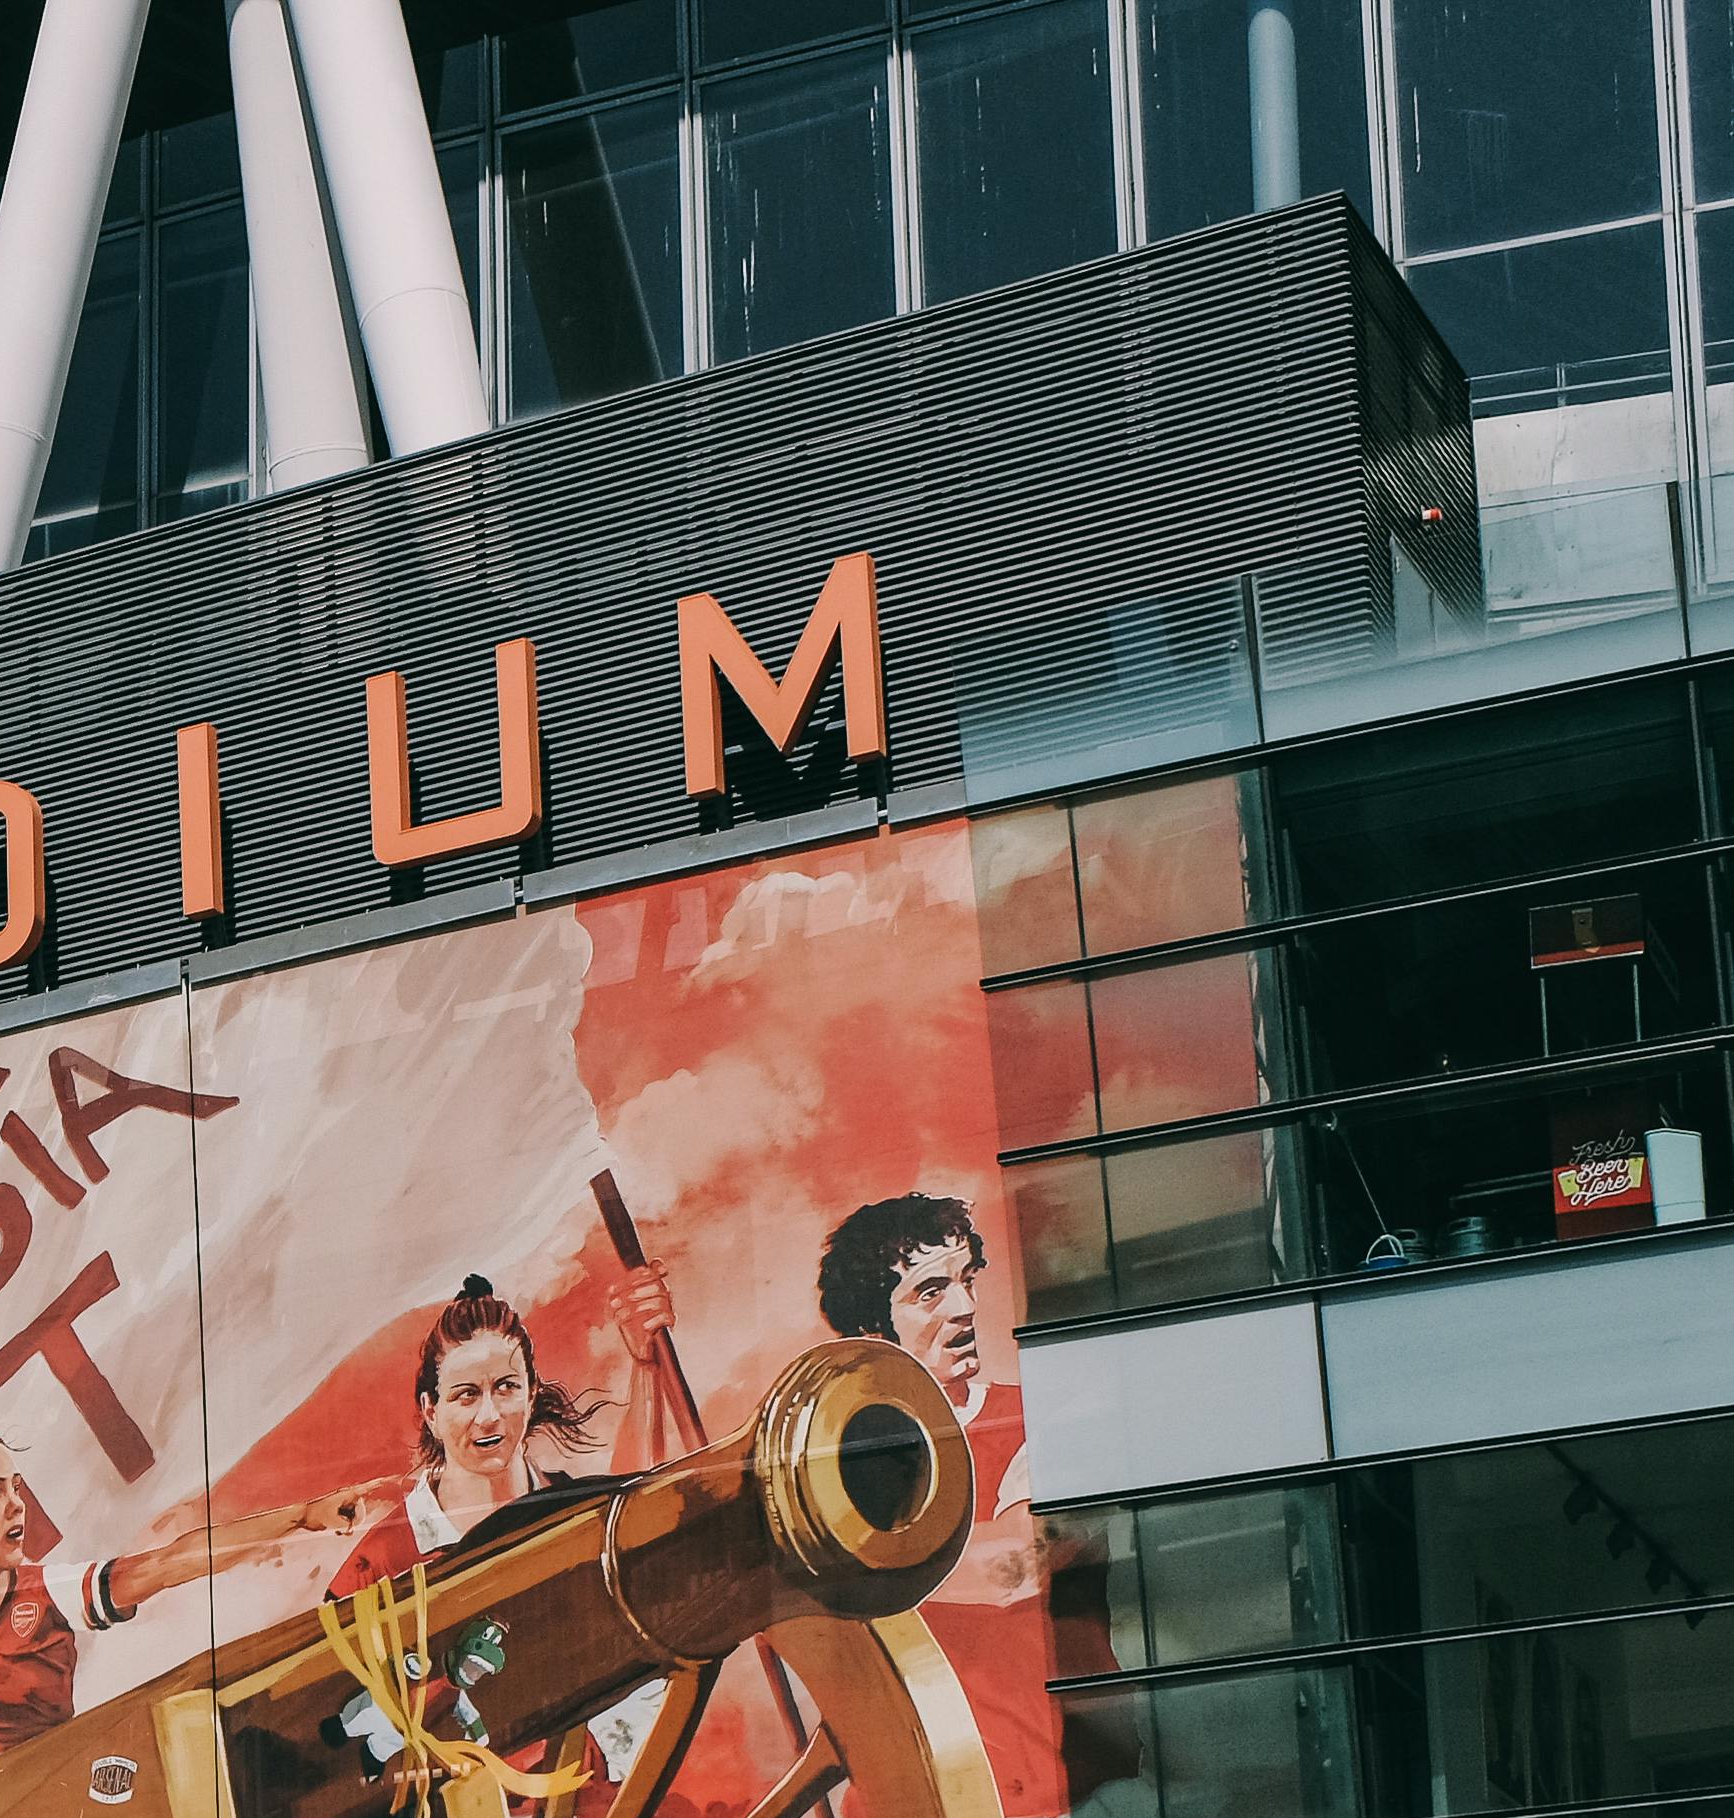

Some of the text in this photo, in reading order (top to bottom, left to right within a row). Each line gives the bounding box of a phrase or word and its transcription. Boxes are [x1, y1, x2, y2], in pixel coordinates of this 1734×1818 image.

[1569, 1129, 1635, 1165] Fresh
[1576, 1159, 1629, 1183] Beer
[1571, 1175, 1632, 1206] Here
[91, 1766, 132, 1794] ARSENAL
